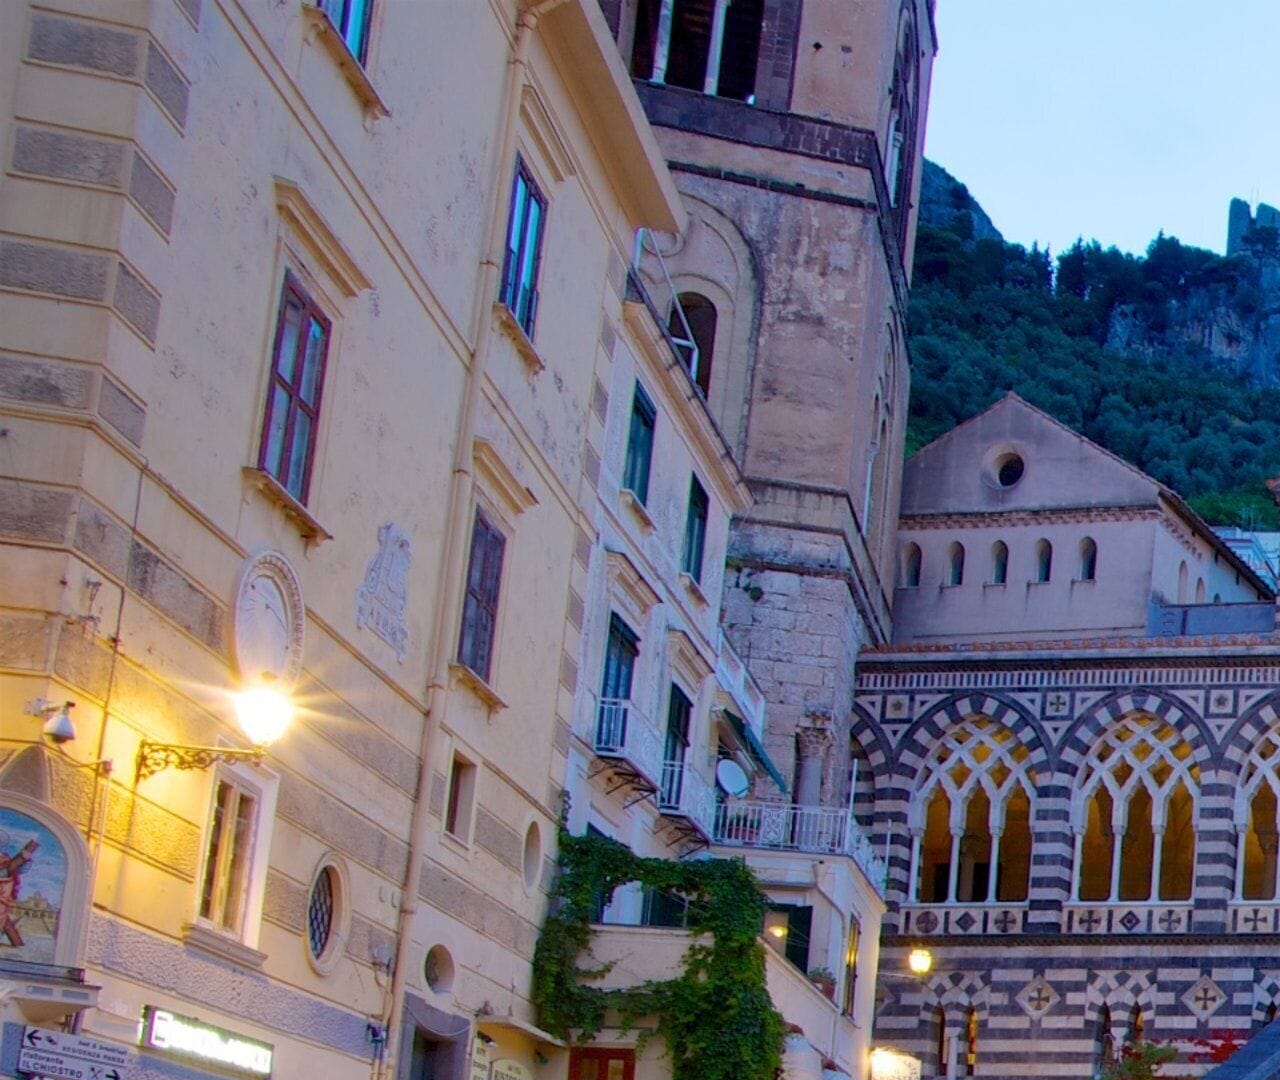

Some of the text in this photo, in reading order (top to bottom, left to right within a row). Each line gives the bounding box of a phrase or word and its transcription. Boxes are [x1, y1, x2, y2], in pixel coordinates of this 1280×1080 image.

[23, 1051, 64, 1065] ristorante
[62, 1046, 125, 1064] RESIDENZA PANSA
[22, 1060, 83, 1079] IL CHIOSTRO
